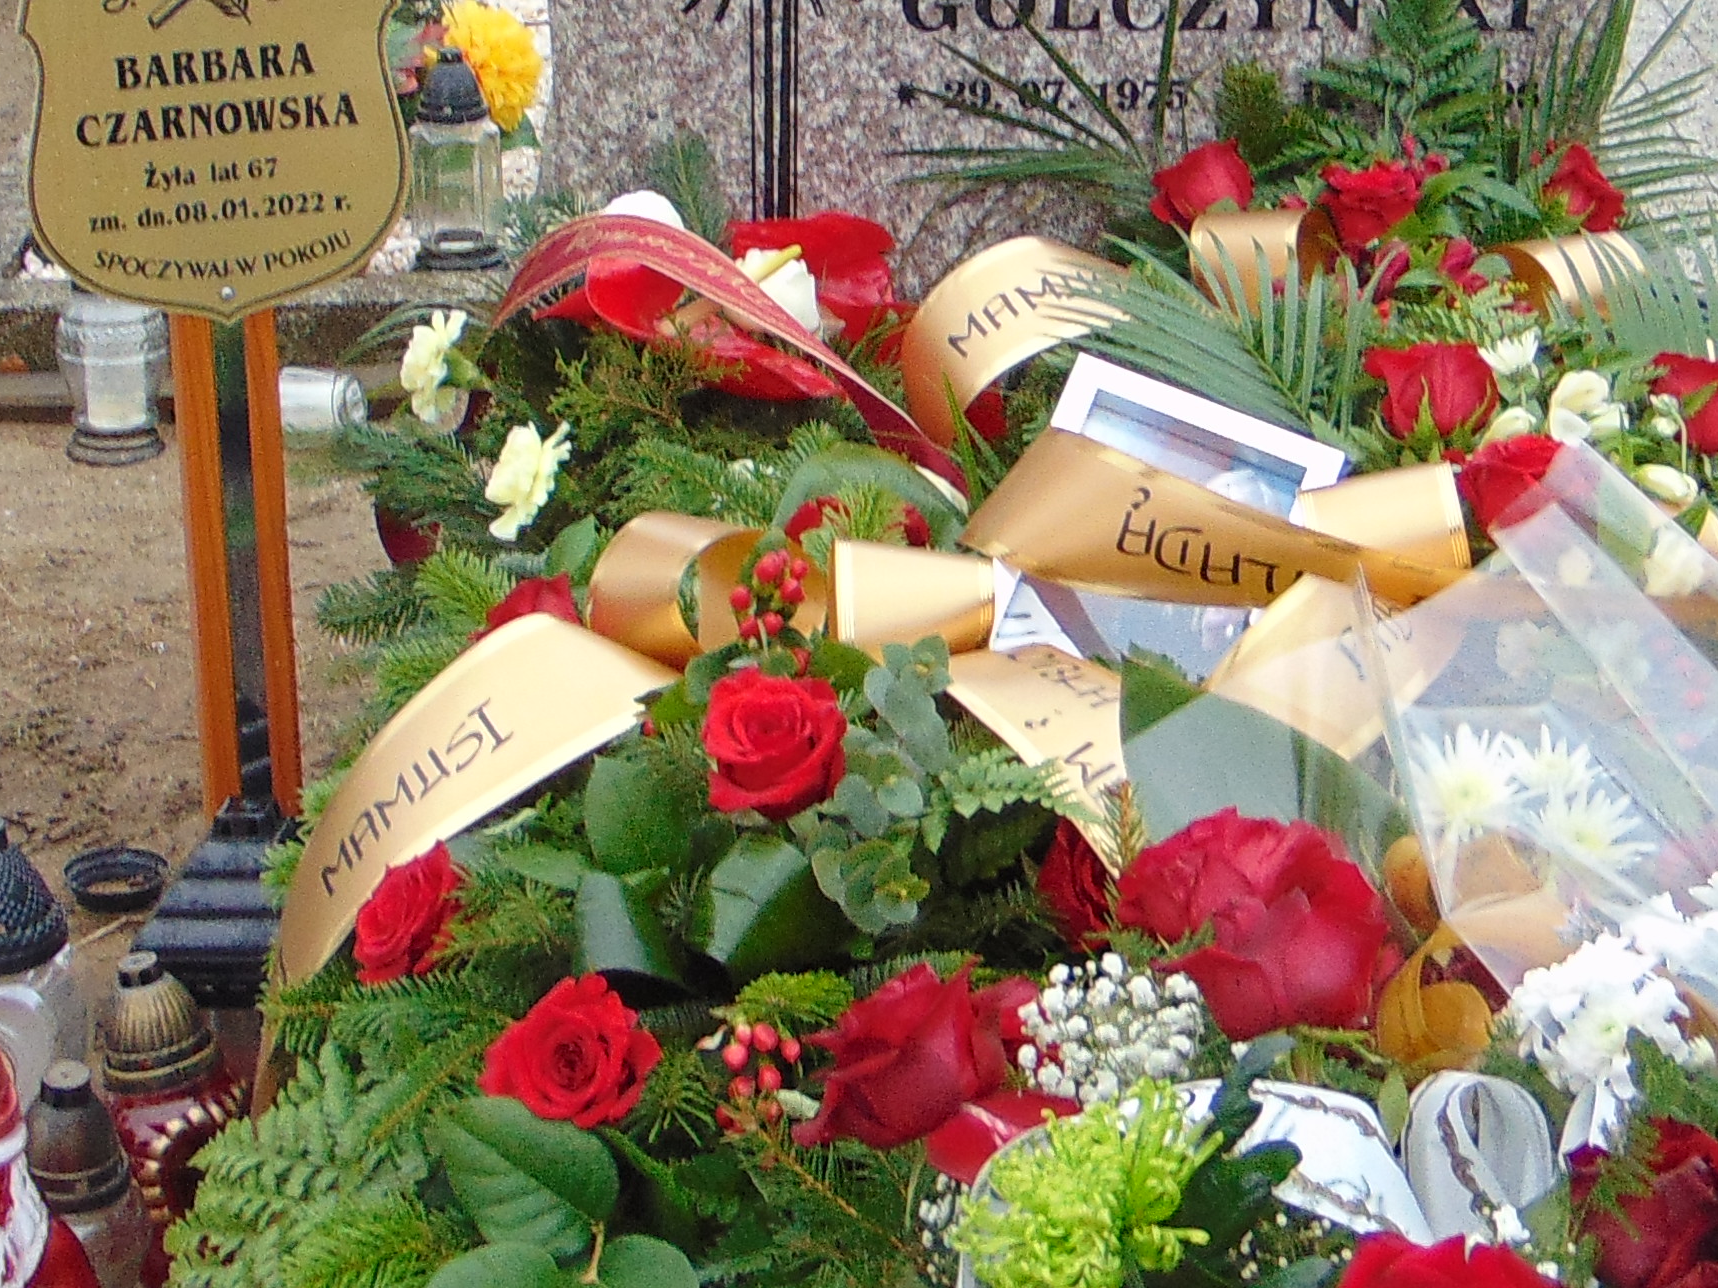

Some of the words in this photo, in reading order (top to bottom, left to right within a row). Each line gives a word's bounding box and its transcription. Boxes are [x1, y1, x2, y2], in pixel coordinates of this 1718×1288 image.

[114, 41, 316, 90] BARBARA
[75, 92, 360, 148] CZARNOWSKA
[144, 161, 197, 191] Żyła
[210, 158, 241, 184] lat
[247, 156, 279, 179] 67
[89, 212, 127, 233] zm.
[333, 192, 352, 212] r.
[94, 247, 232, 281] SPOCZYWAJ
[232, 256, 257, 276] W
[264, 227, 353, 273] POKOJU
[320, 696, 515, 898] MAMUSI
